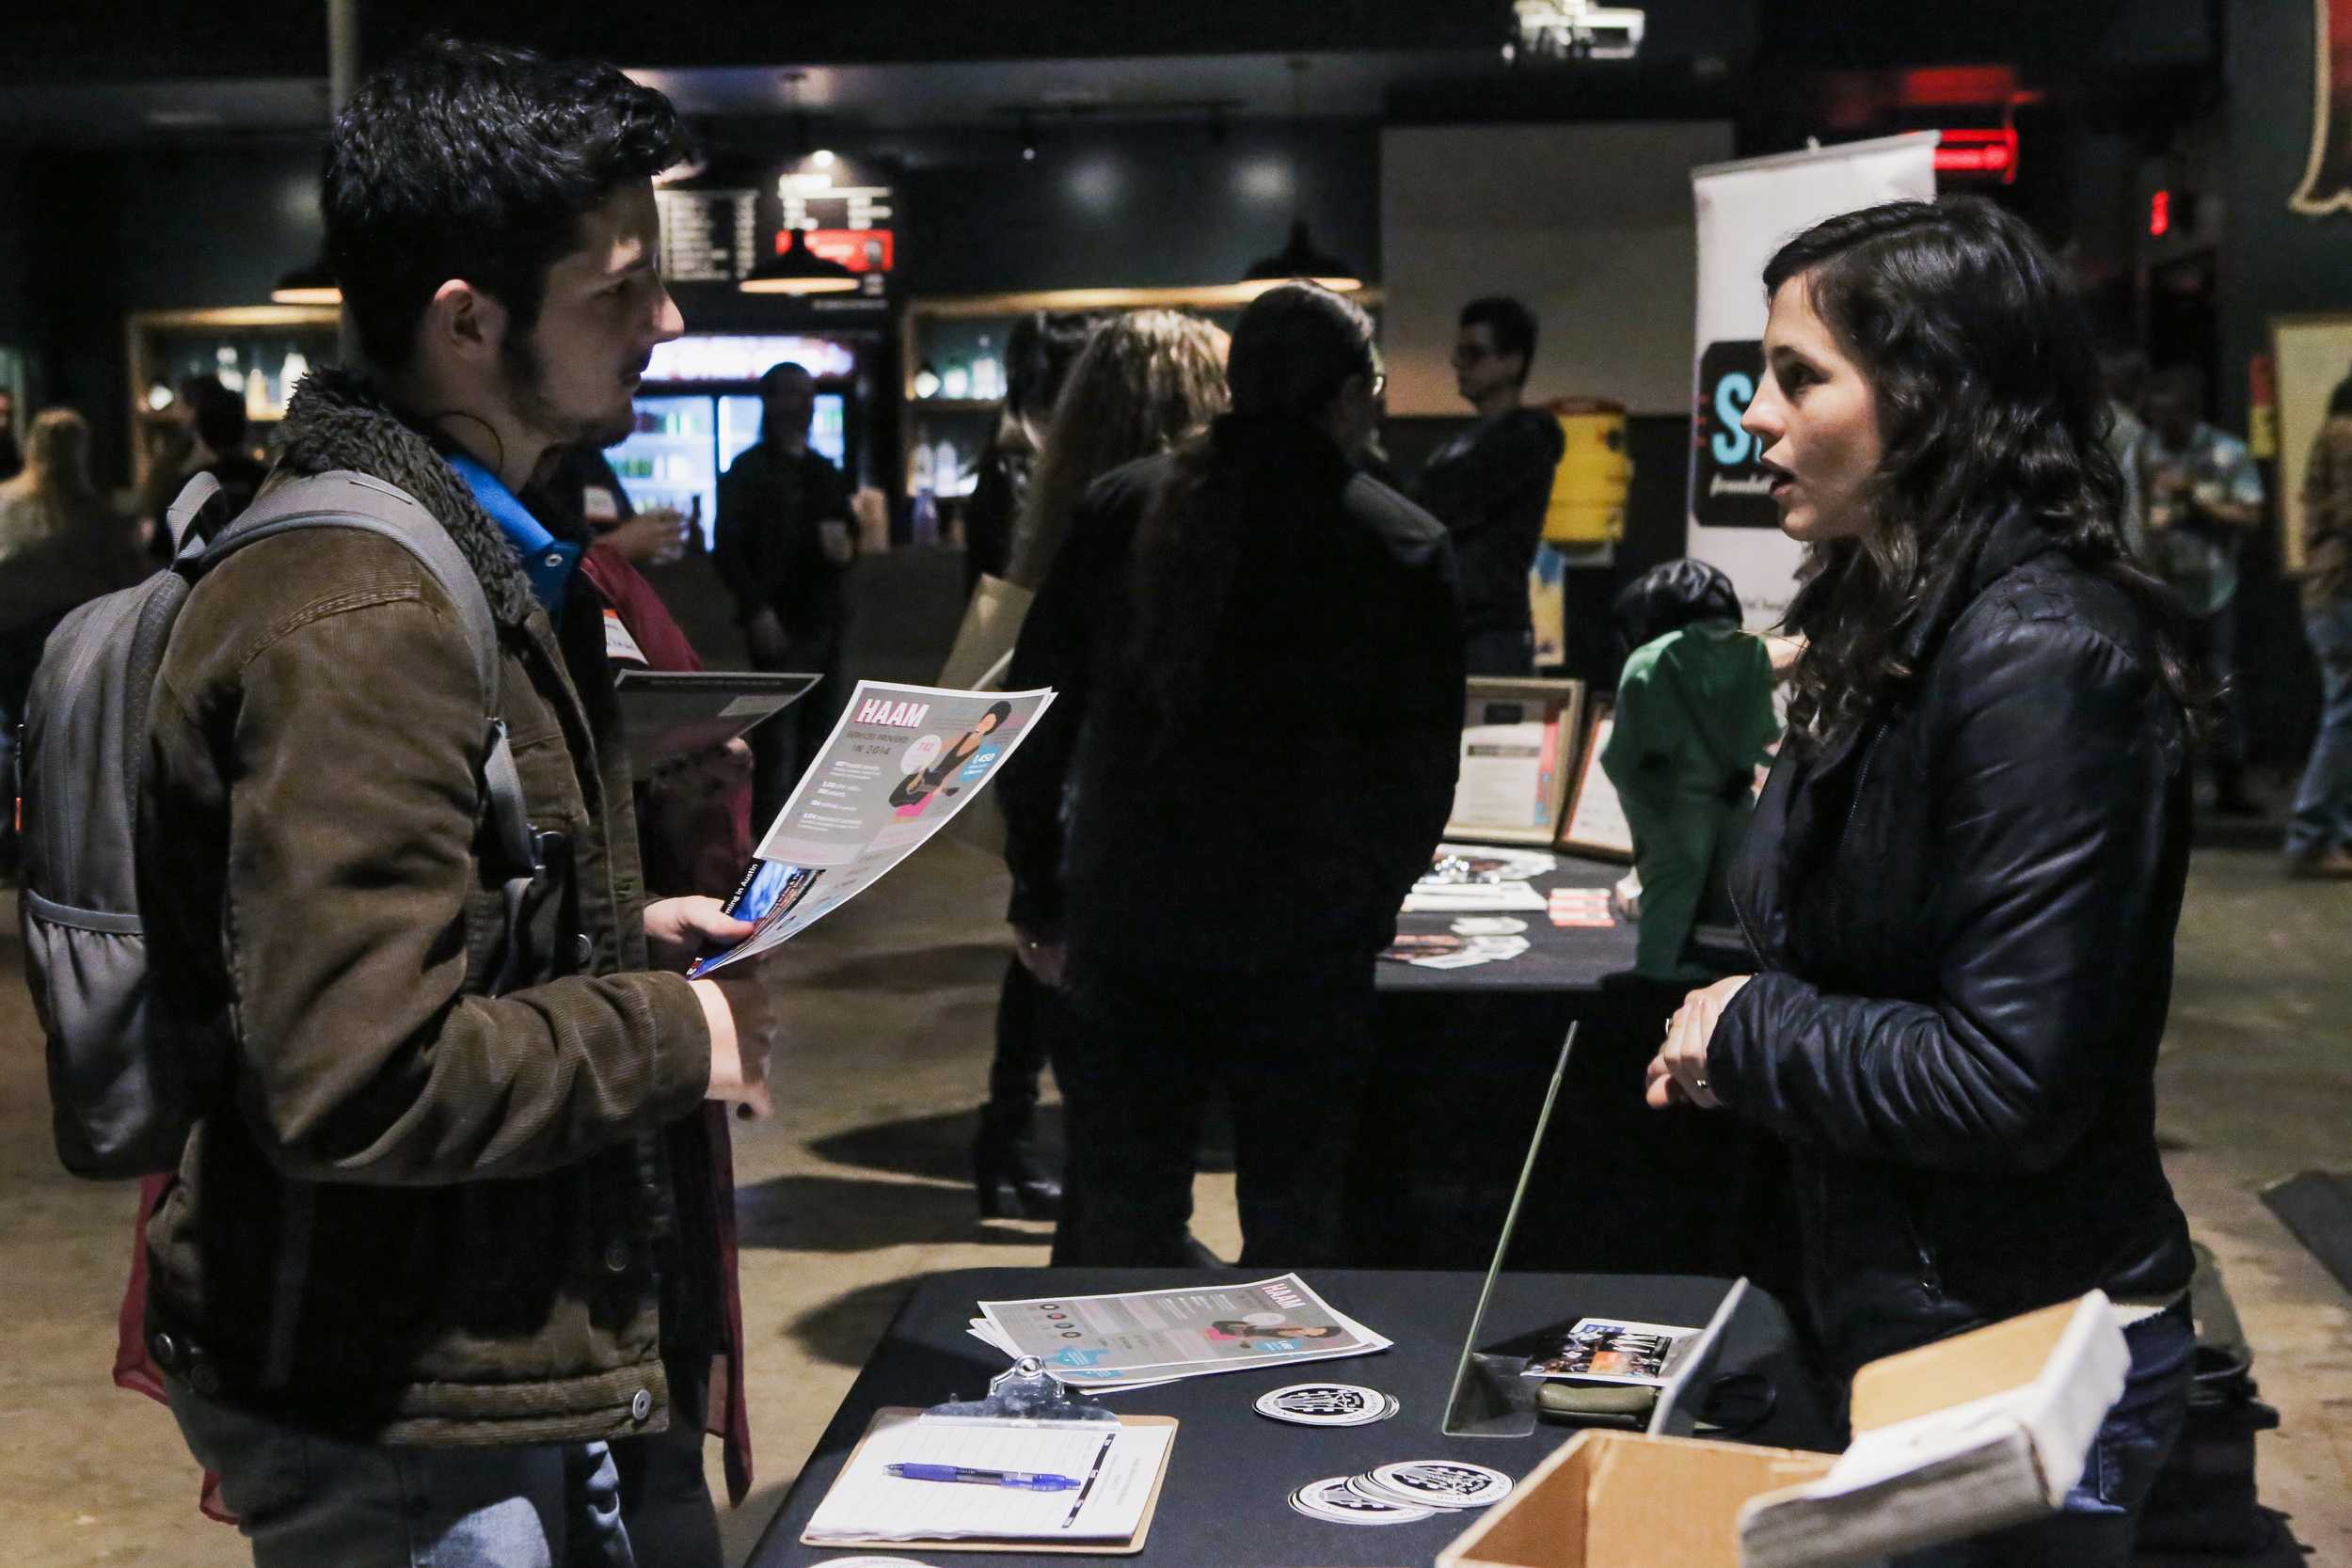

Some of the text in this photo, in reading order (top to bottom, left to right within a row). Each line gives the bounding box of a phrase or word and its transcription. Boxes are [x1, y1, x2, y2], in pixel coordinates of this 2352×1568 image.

[855, 699, 930, 728] HAAM
[724, 895, 741, 914] ming
[741, 863, 758, 887] Austin
[1262, 1282, 1307, 1309] HAAM
